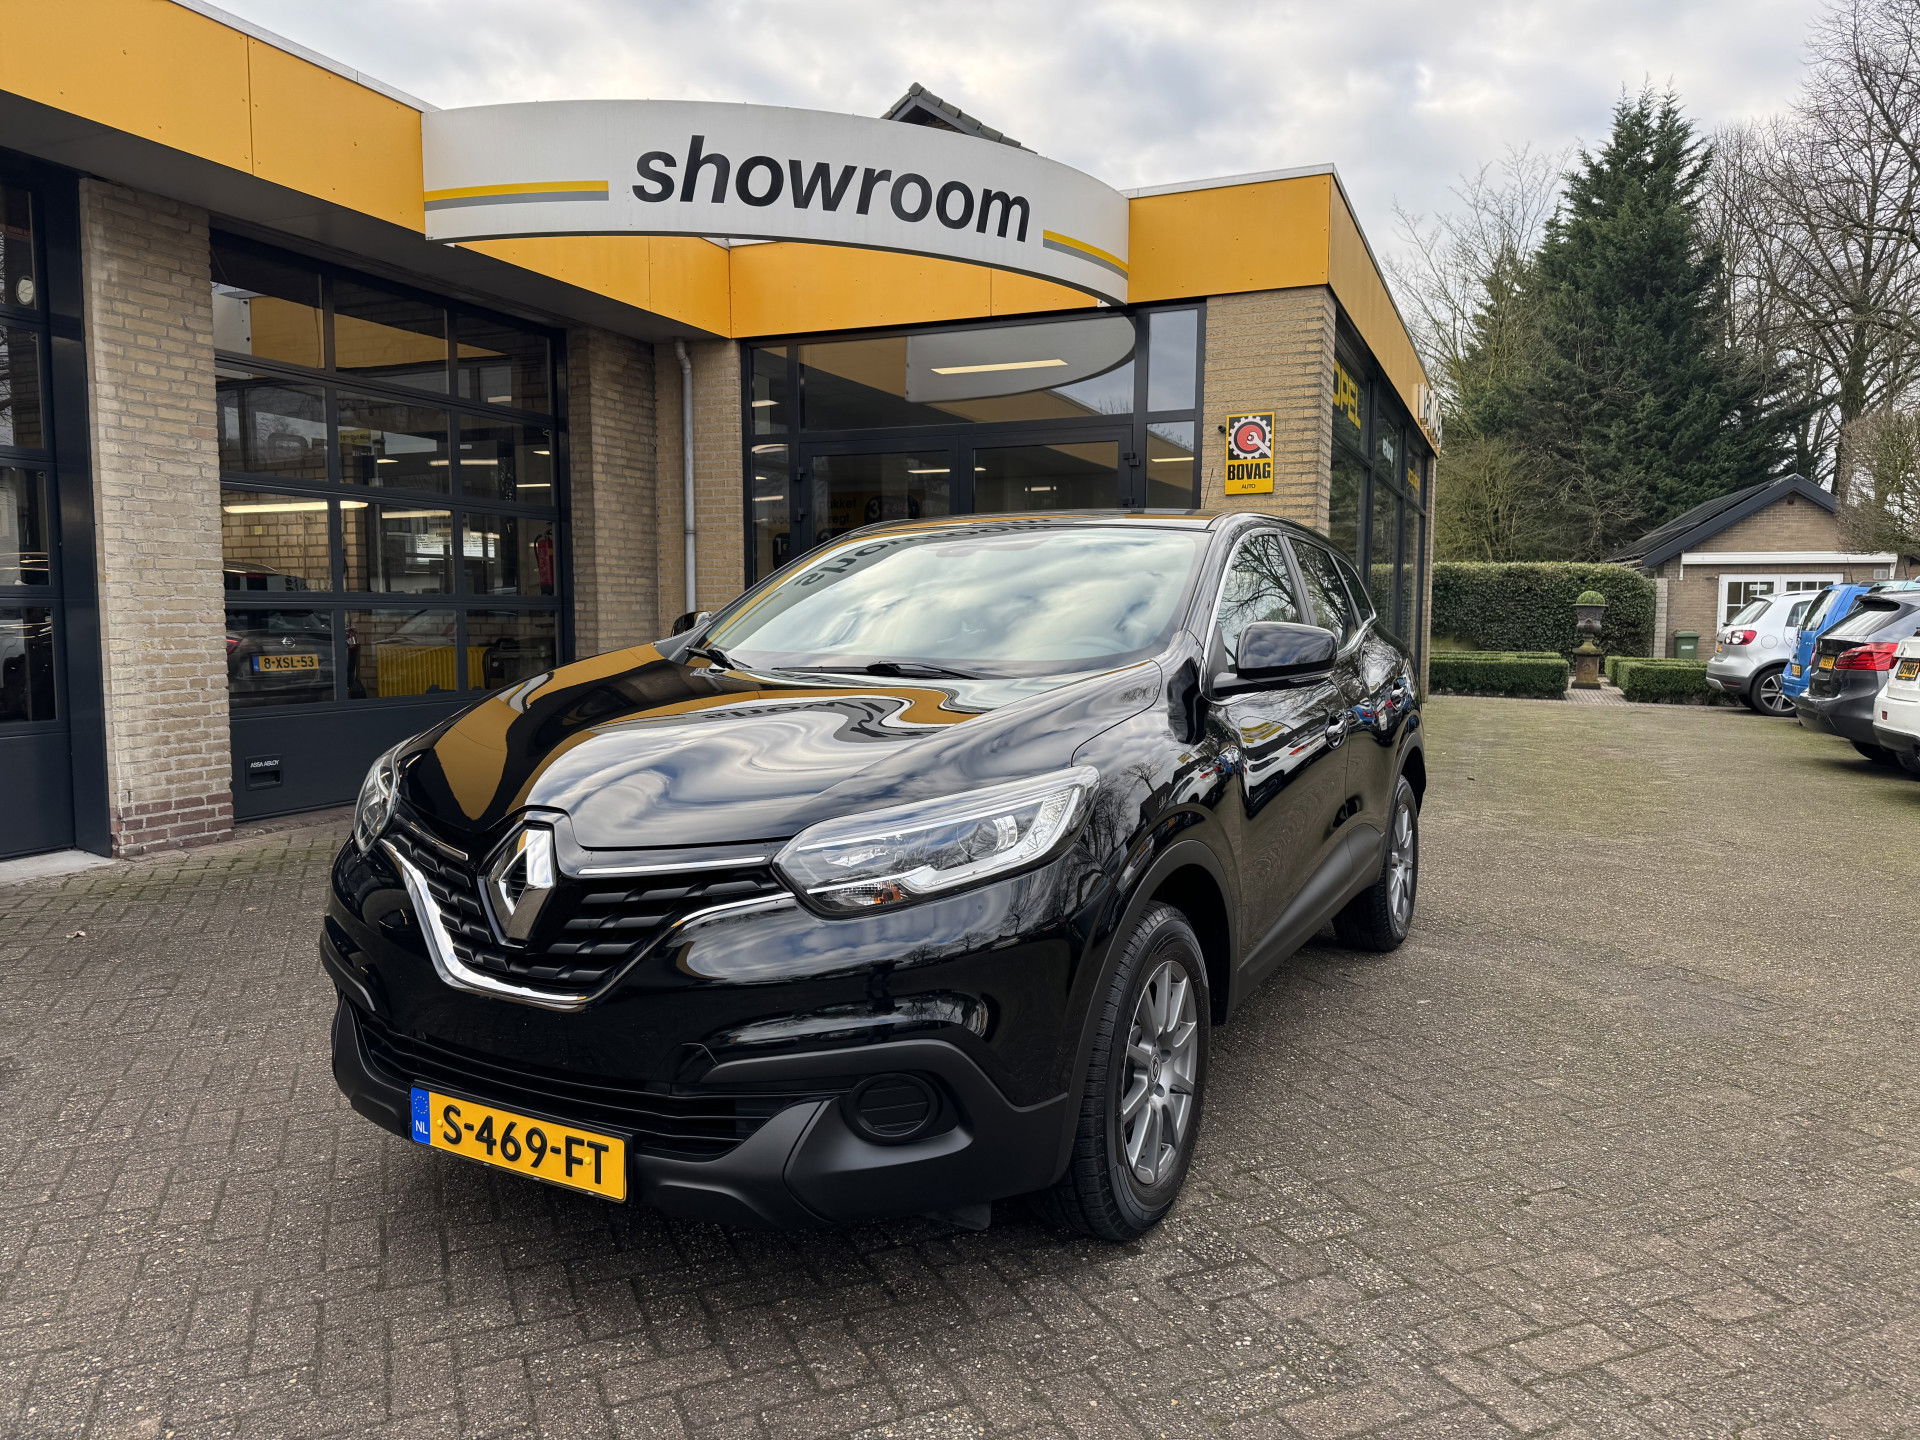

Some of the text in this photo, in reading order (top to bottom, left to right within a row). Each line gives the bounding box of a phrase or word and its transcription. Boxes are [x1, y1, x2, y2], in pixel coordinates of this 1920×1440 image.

[632, 134, 1031, 243] showroom
[1227, 462, 1272, 481] BOVAG
[263, 655, 314, 670] 8-XSL-53
[250, 759, 280, 769] ASSA ABLOY
[415, 1103, 610, 1185] NL S-469-FT
